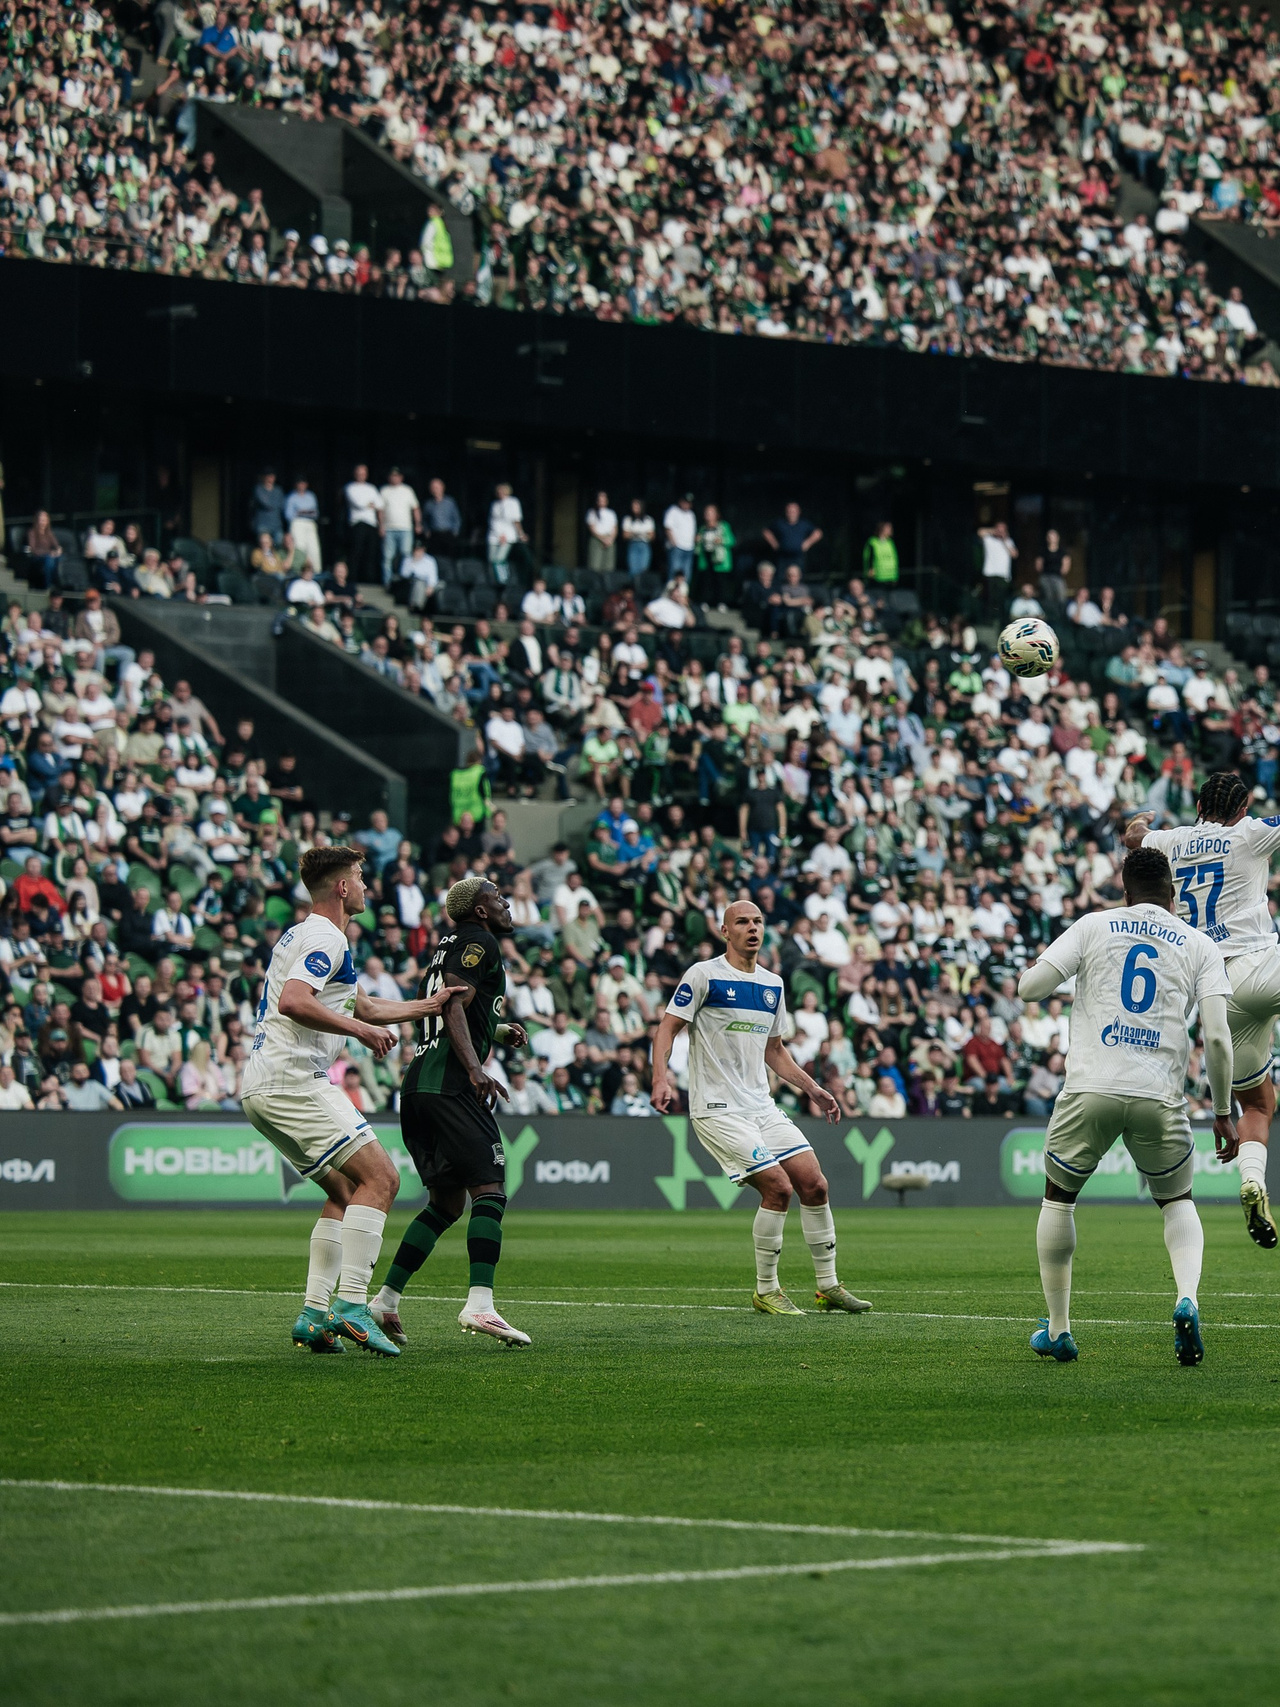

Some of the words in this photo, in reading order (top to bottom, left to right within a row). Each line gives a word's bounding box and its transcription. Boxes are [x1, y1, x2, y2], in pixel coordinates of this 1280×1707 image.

[1175, 861, 1225, 929] 37
[1109, 920, 1187, 946] ПАЛАСИОС
[1120, 943, 1159, 1014] 6
[1120, 1025, 1161, 1042] ГАЗПРОМ
[0, 1158, 55, 1183] ФЛ
[124, 1141, 275, 1175] НОВЫЙ
[535, 1159, 611, 1184] ЮФЛ
